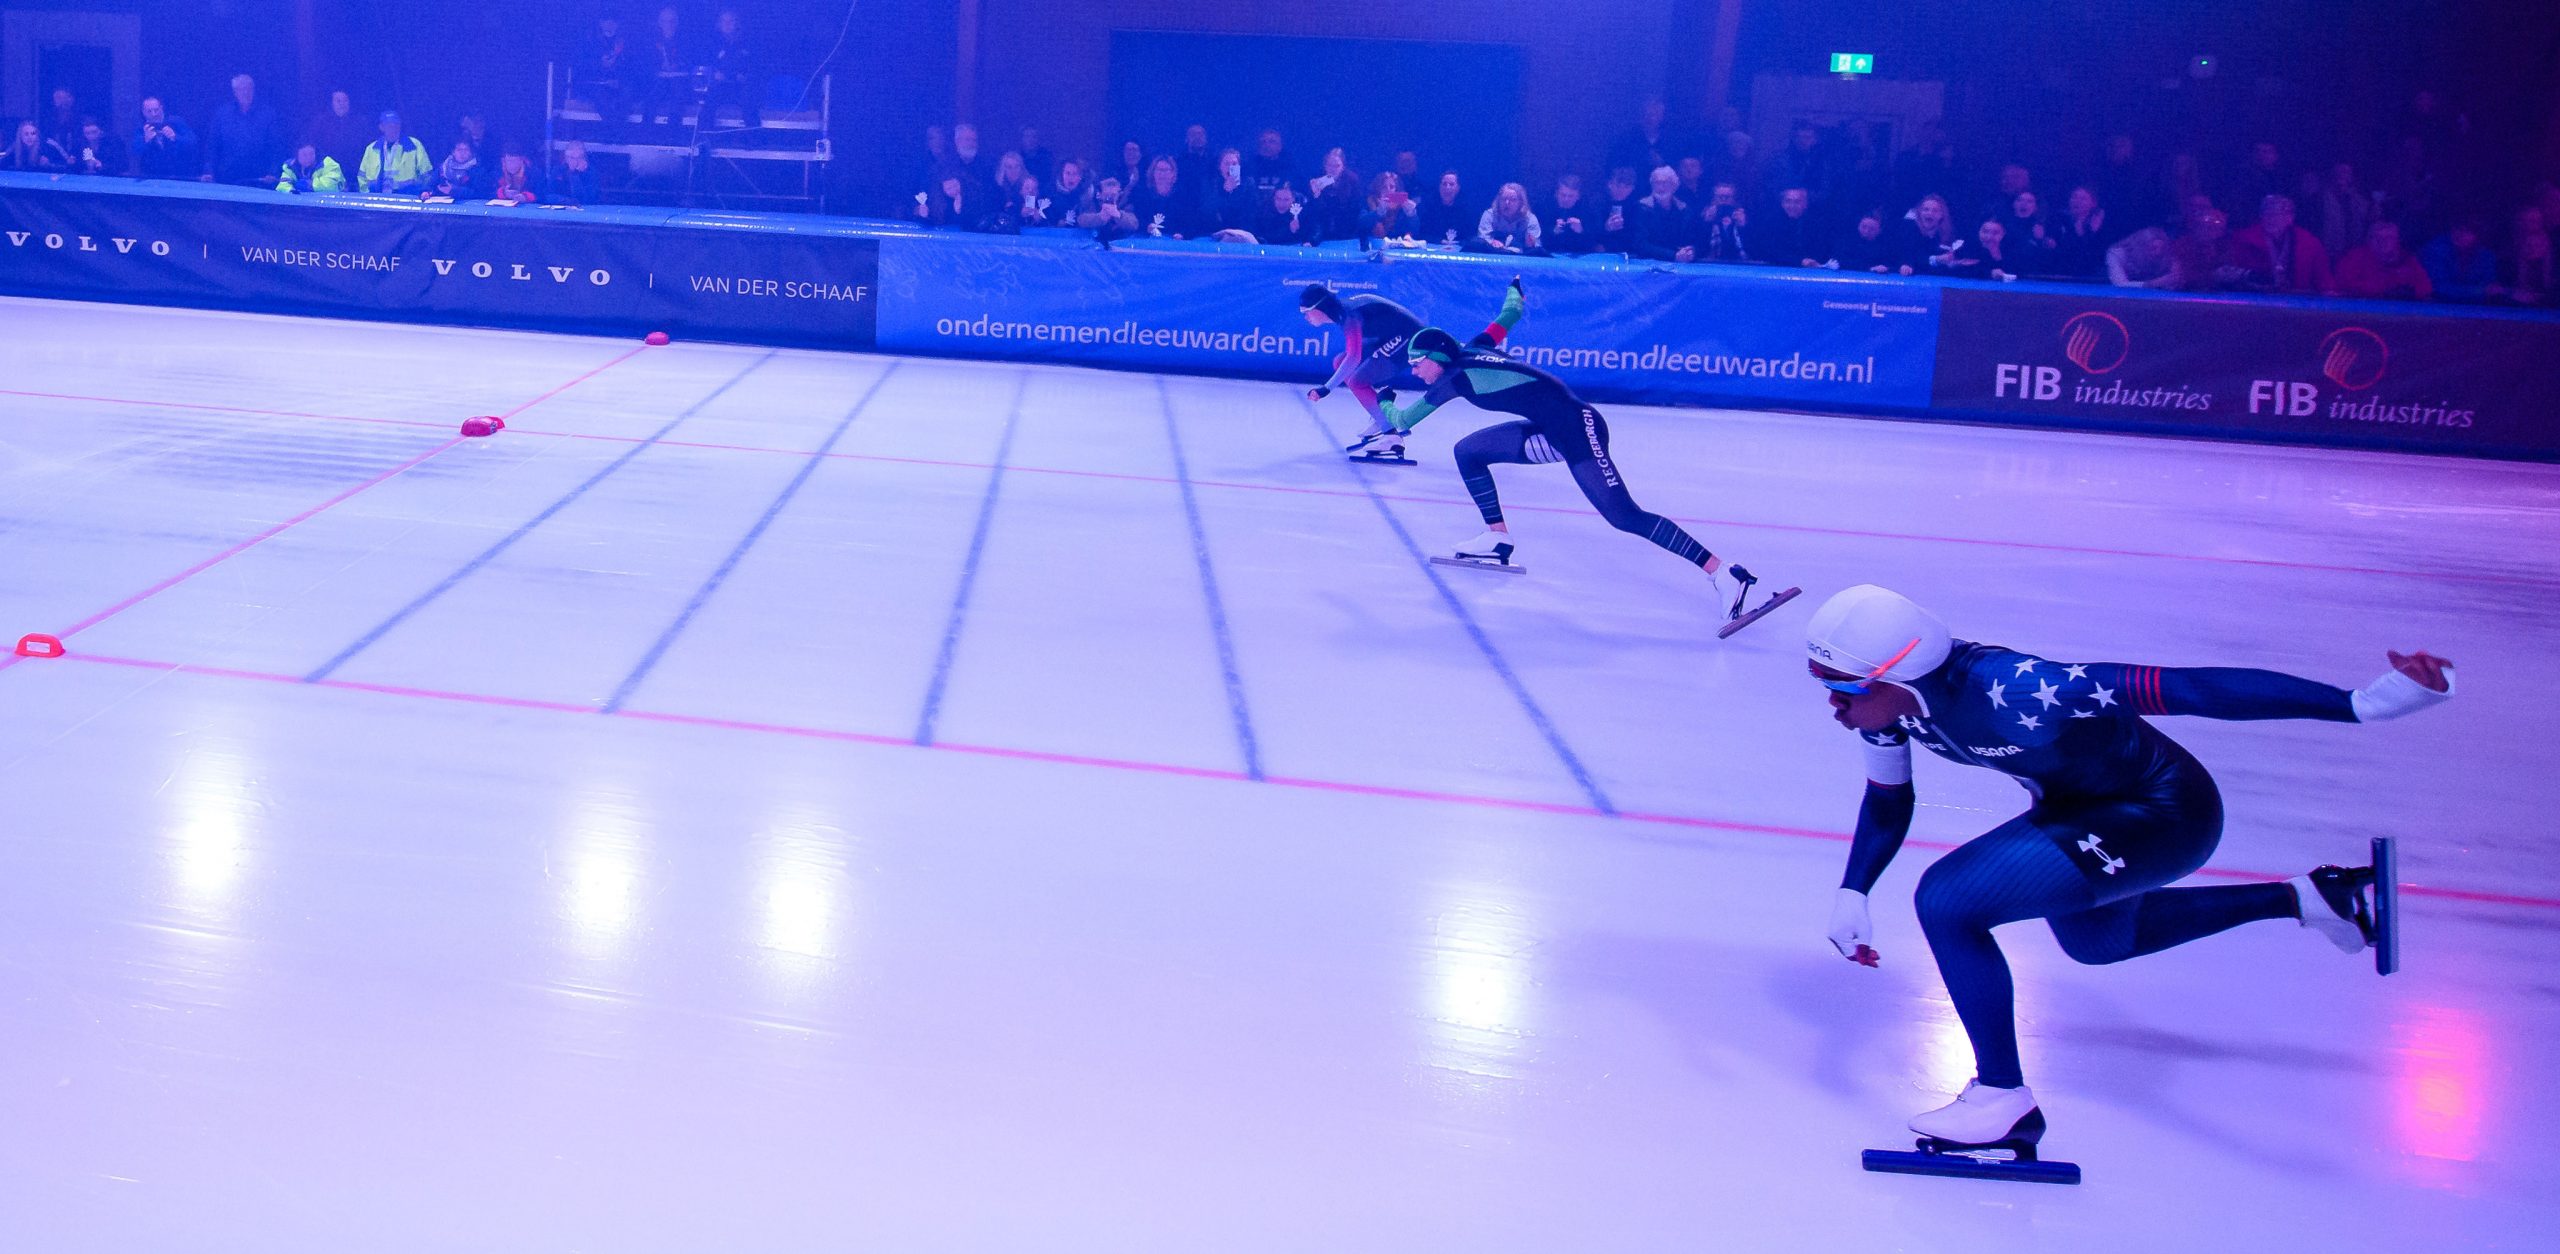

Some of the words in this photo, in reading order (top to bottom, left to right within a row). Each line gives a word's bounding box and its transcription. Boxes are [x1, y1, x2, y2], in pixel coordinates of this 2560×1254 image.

[6, 231, 170, 256] VOLVO
[241, 246, 278, 264] VAN
[283, 249, 321, 267] DER
[326, 252, 401, 272] SCHAAF
[431, 258, 611, 286] VOLVO
[690, 275, 730, 294] VAN
[737, 278, 779, 297] DER
[785, 281, 868, 302] SCHAAF
[936, 314, 1329, 357] ondernemendleeuwarden.nl
[1494, 337, 1874, 384] ernemendleeuwarden.nl
[1995, 363, 2062, 401] FIB
[2074, 378, 2212, 411] industries
[2249, 379, 2319, 417] FIB
[2329, 394, 2474, 428] industries
[1968, 745, 2025, 757] USANA
